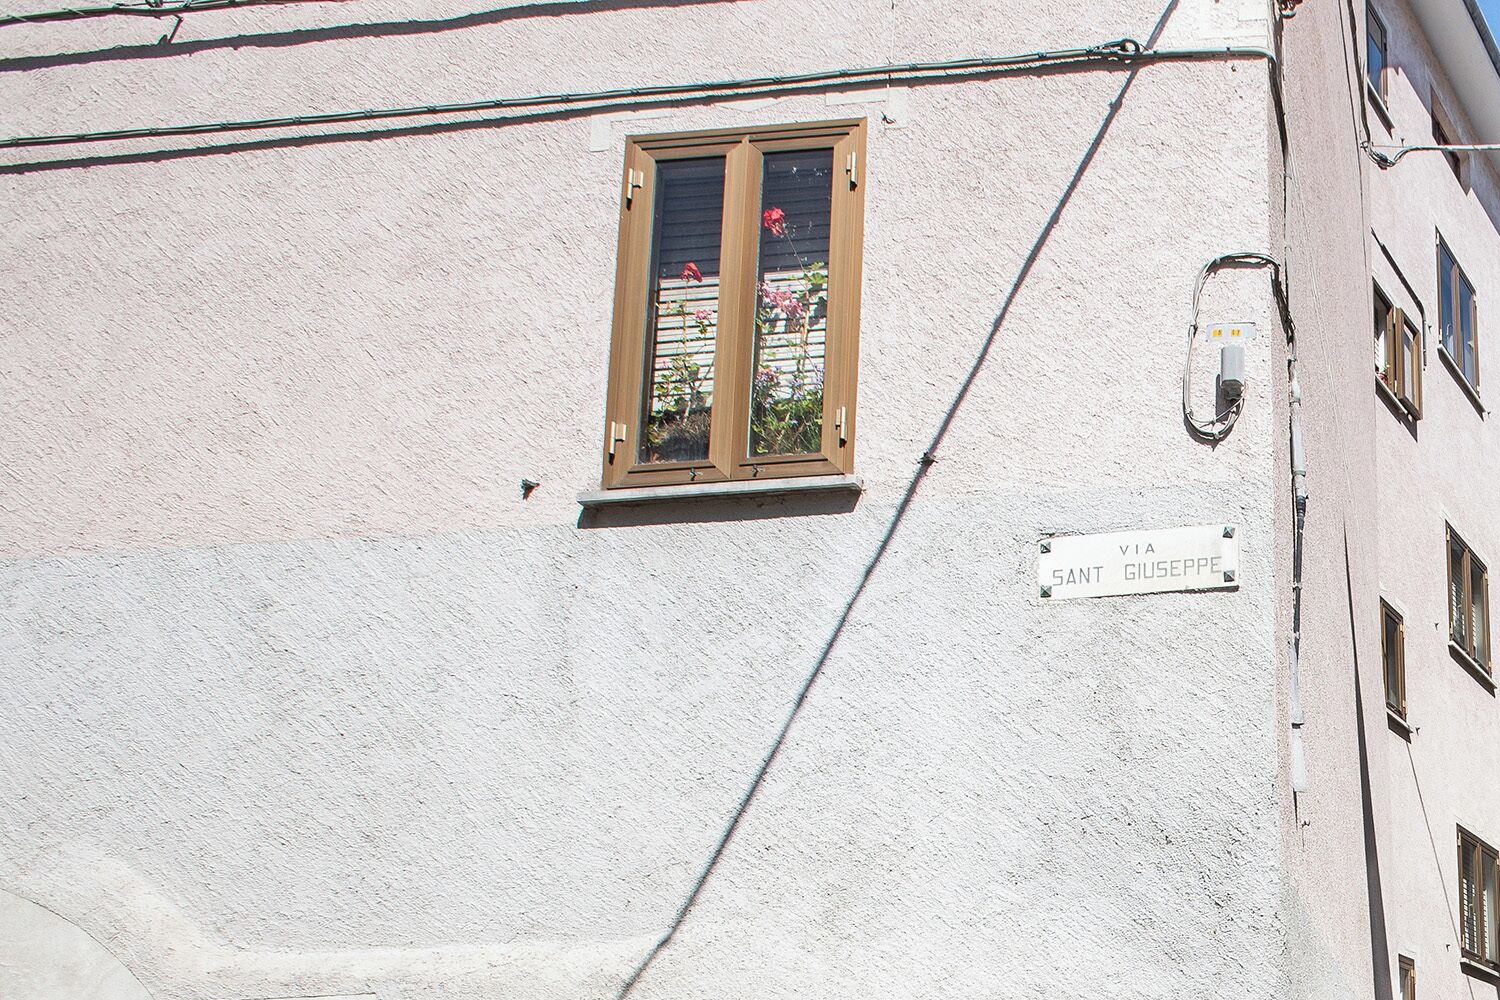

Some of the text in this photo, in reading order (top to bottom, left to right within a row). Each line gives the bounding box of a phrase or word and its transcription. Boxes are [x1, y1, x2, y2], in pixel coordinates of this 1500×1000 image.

[1119, 543, 1155, 556] VIA
[1052, 556, 1223, 587] SANT GIUSEPPE
